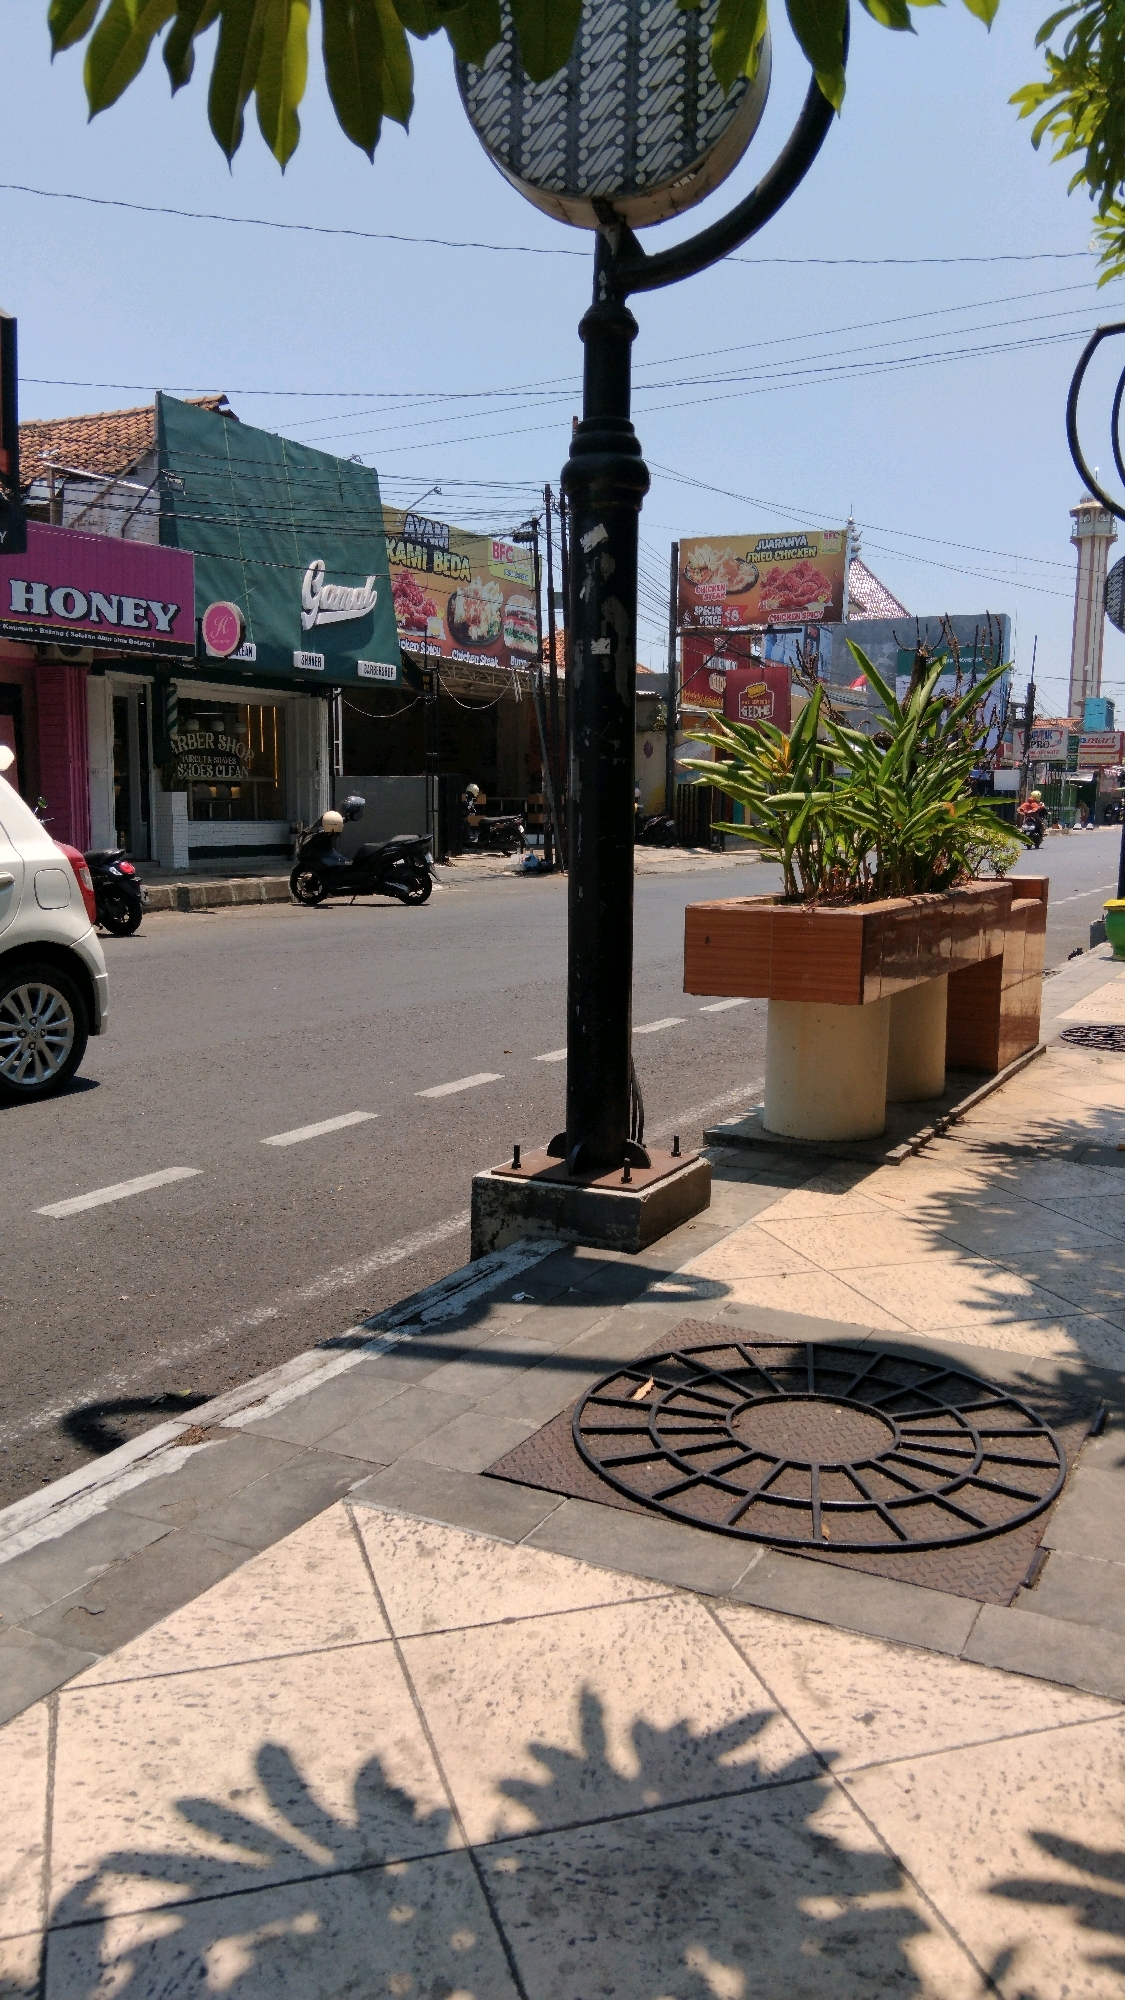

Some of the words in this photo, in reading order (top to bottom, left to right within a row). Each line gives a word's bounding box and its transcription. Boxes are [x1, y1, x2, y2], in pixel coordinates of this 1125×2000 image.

[756, 534, 808, 551] JUARANYA
[823, 531, 839, 540] BFC
[492, 541, 514, 563] BFC
[746, 551, 773, 563] FRIED
[774, 546, 817, 561] CHICKEN
[695, 584, 727, 595] CHICKEN
[703, 592, 727, 601] STEAK
[9, 578, 181, 633] HONEY
[700, 615, 722, 625] PRICE
[768, 612, 801, 623] CHICKEN
[802, 610, 824, 621] SPICY
[301, 654, 322, 668] SHAVER
[451, 649, 479, 665] Chicken
[479, 654, 499, 667] Steak
[741, 705, 771, 718] GEDHE
[170, 732, 215, 755] ARBER
[217, 734, 255, 763] SHOP
[177, 764, 214, 779] SHOES
[215, 765, 249, 778] CLEAN
